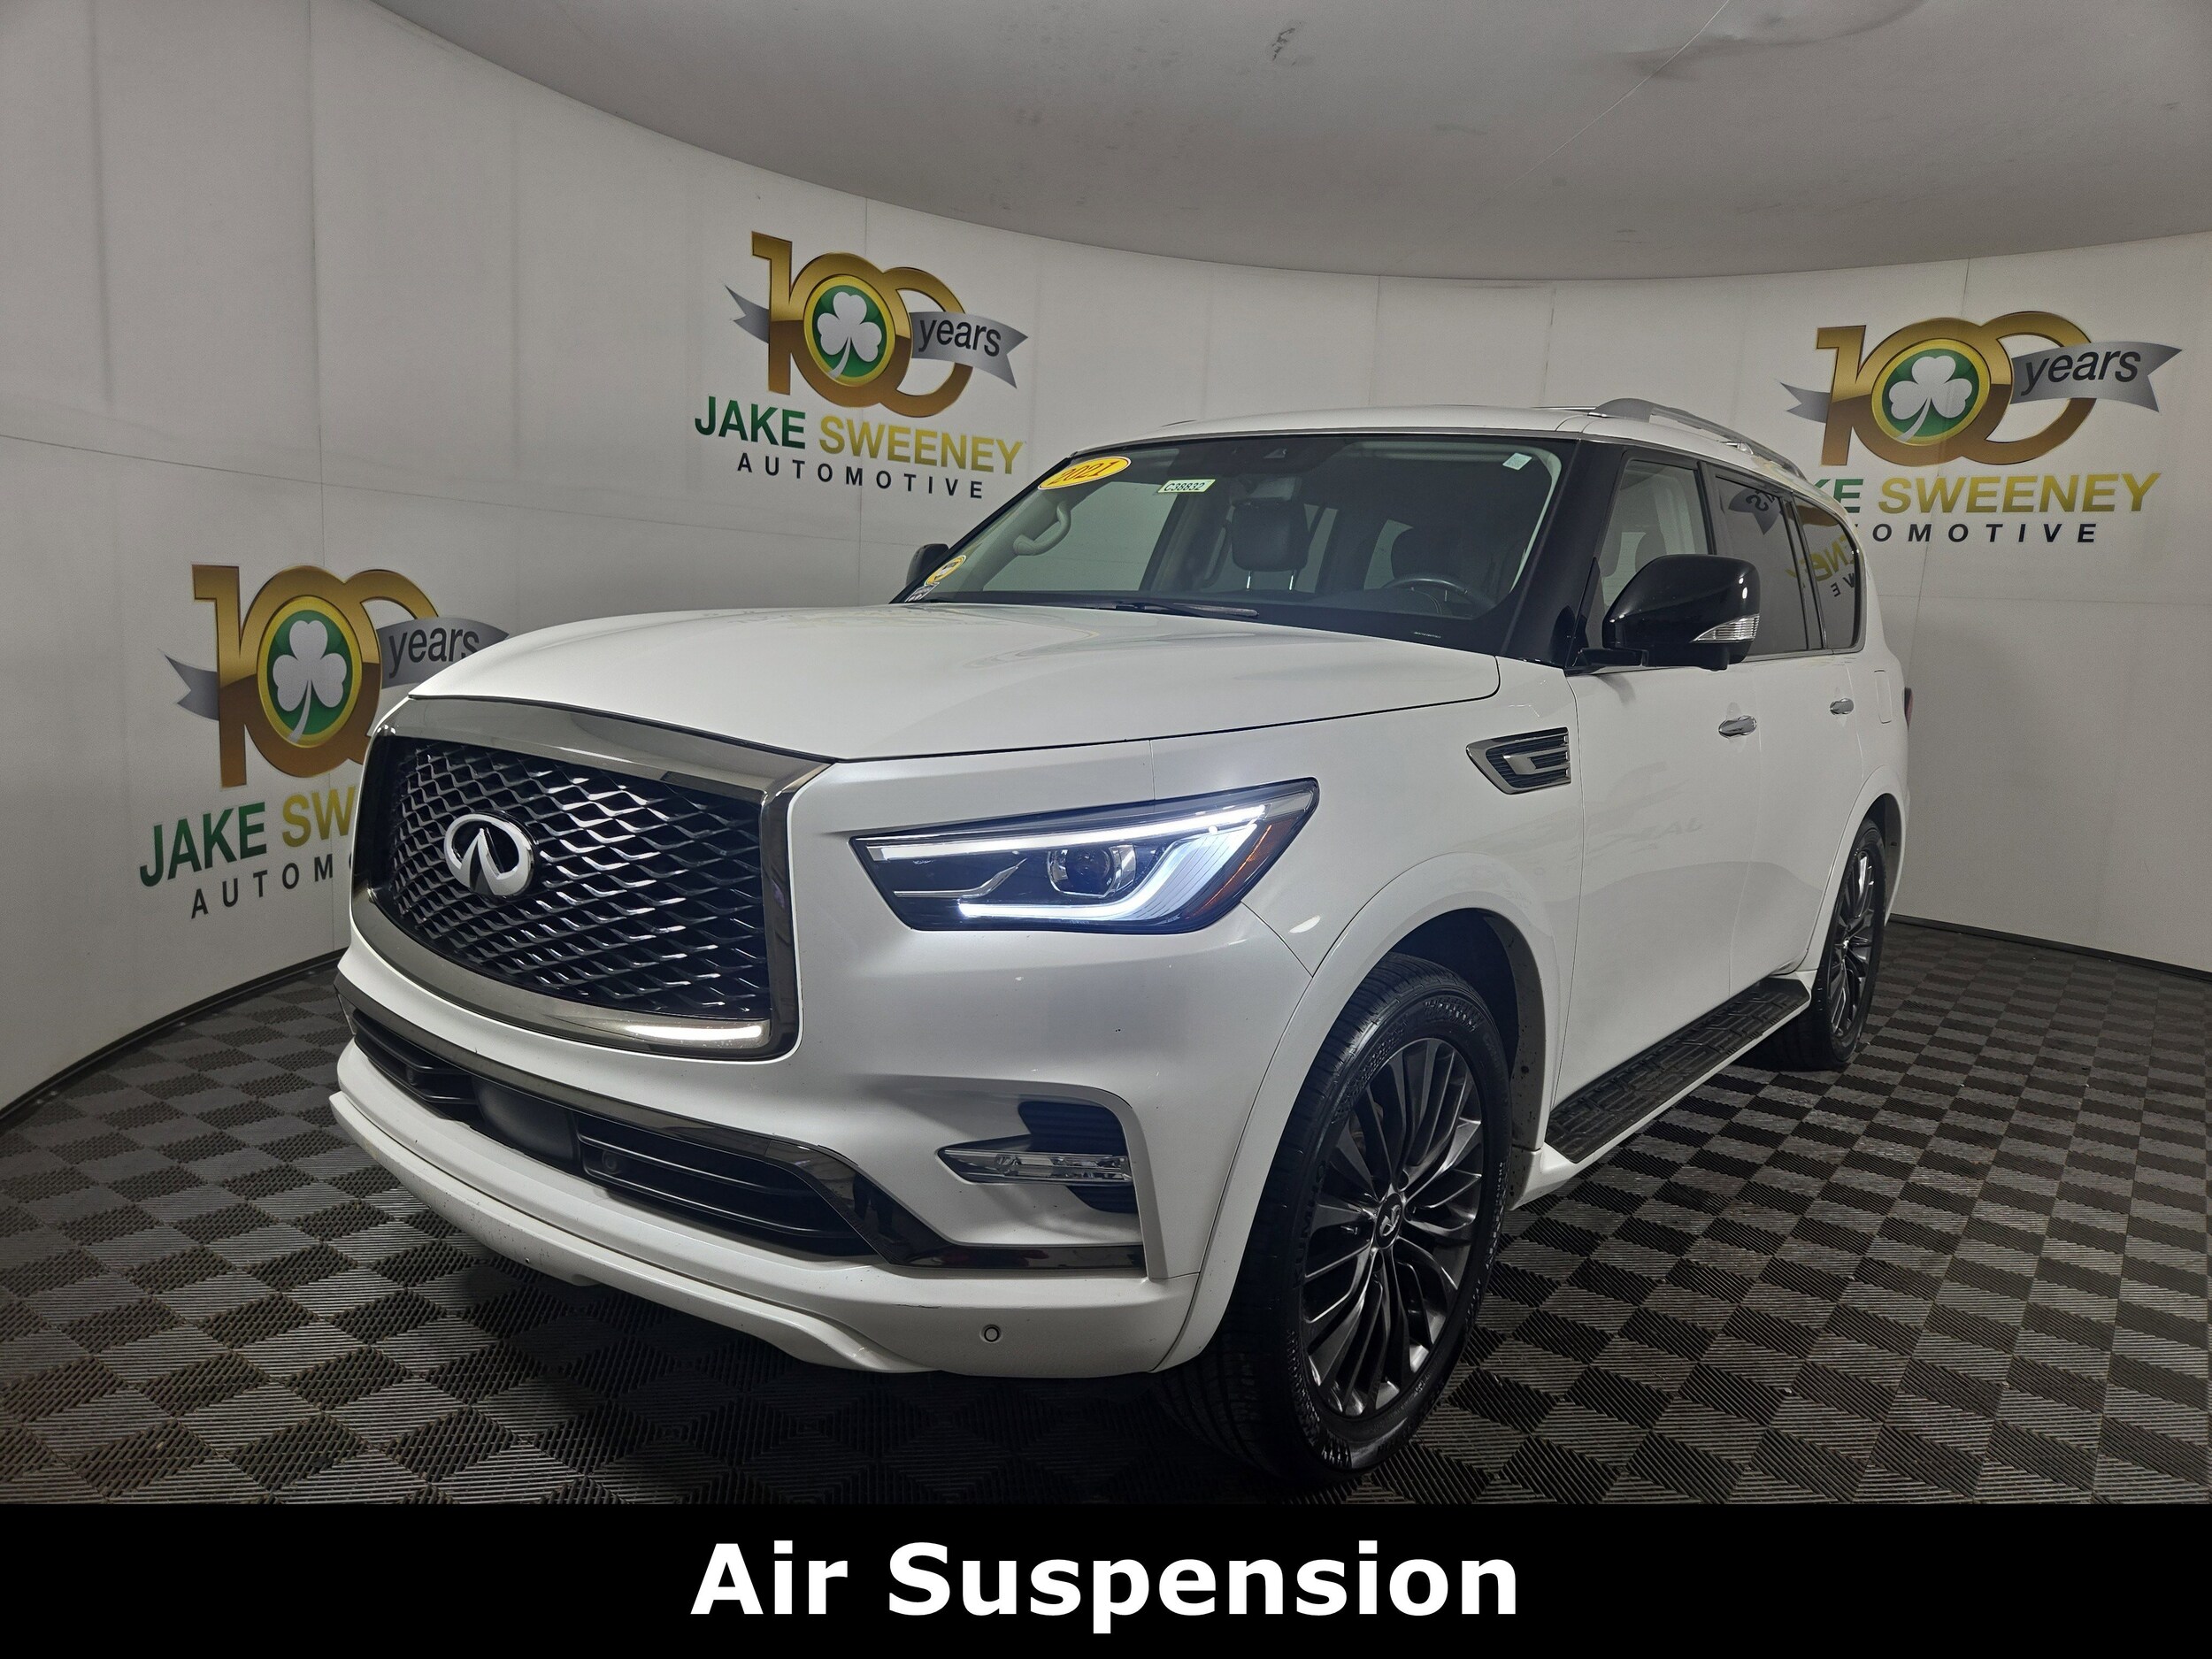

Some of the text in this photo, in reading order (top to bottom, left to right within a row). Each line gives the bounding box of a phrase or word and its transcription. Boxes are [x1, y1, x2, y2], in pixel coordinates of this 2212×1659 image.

[918, 318, 1002, 357] years
[2020, 349, 2142, 397] years
[695, 395, 1024, 475] JAKE SWEENEY
[737, 452, 983, 499] AUTOMOTIVE
[1049, 460, 1120, 485] 2021
[1164, 482, 1205, 492] C38832
[1878, 472, 2162, 515] SWEENEY
[1855, 523, 2097, 543] OMOTIVE
[388, 626, 480, 679] years
[139, 801, 267, 887] JAKE
[191, 853, 352, 919] AUTOM
